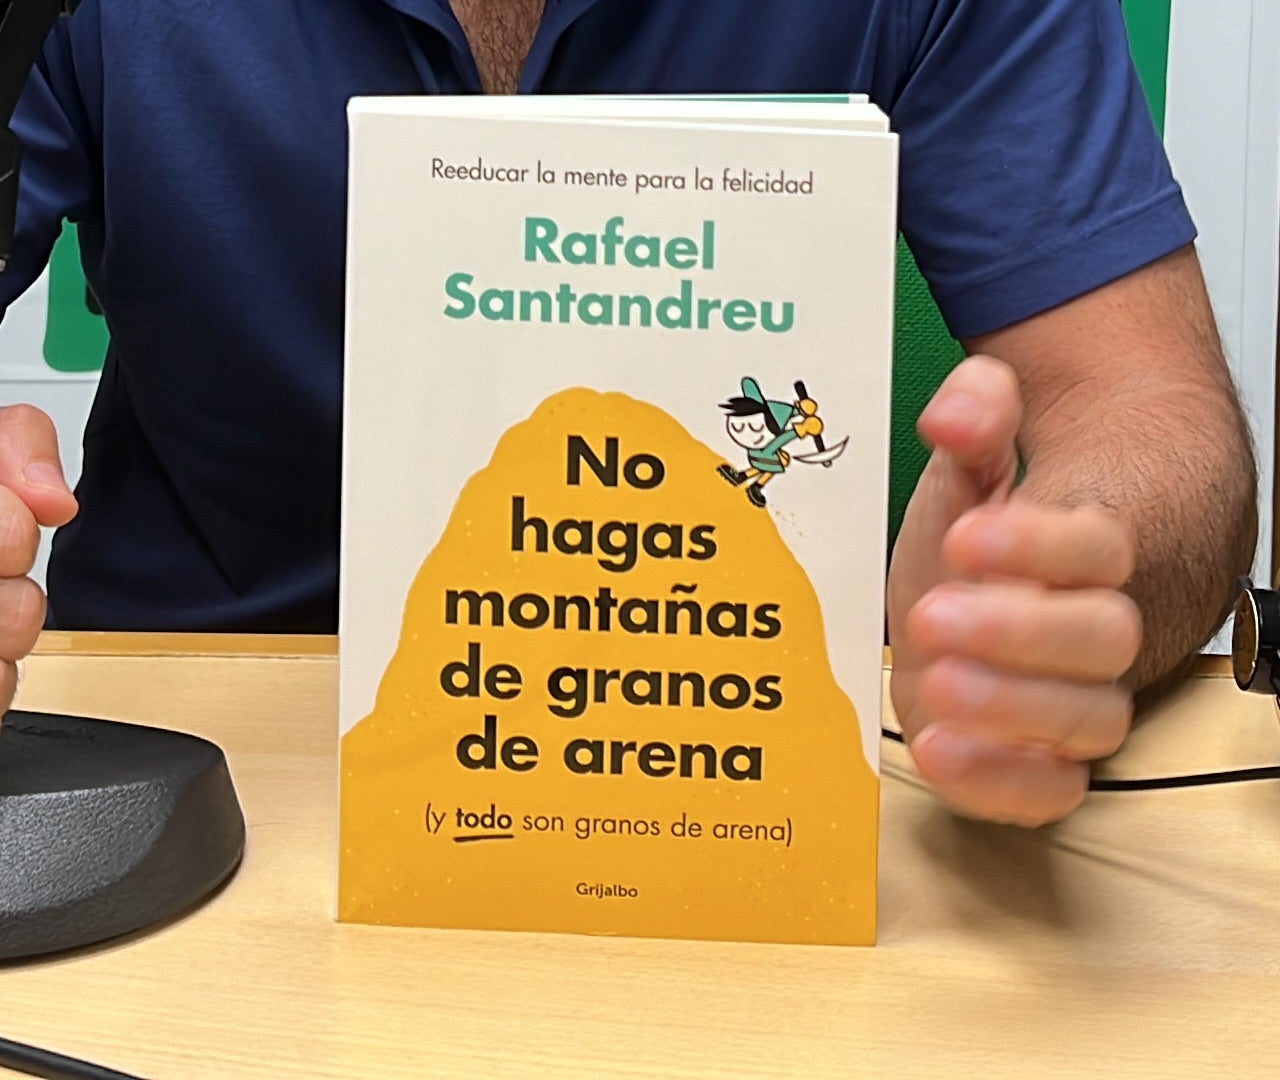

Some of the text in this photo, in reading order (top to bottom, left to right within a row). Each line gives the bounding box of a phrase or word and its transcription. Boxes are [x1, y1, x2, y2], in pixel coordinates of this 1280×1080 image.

[431, 157, 814, 195] Reeducar la mente para la felicidad
[524, 216, 715, 270] Rafael
[443, 272, 795, 333] Santandreu
[566, 434, 666, 490] No
[511, 496, 718, 572] hagas
[445, 583, 783, 640] montañas
[439, 642, 784, 718] de granos
[456, 715, 763, 781] de arena
[425, 803, 793, 847] (y todo son granos de arena)
[575, 882, 639, 899] Grijalbo
